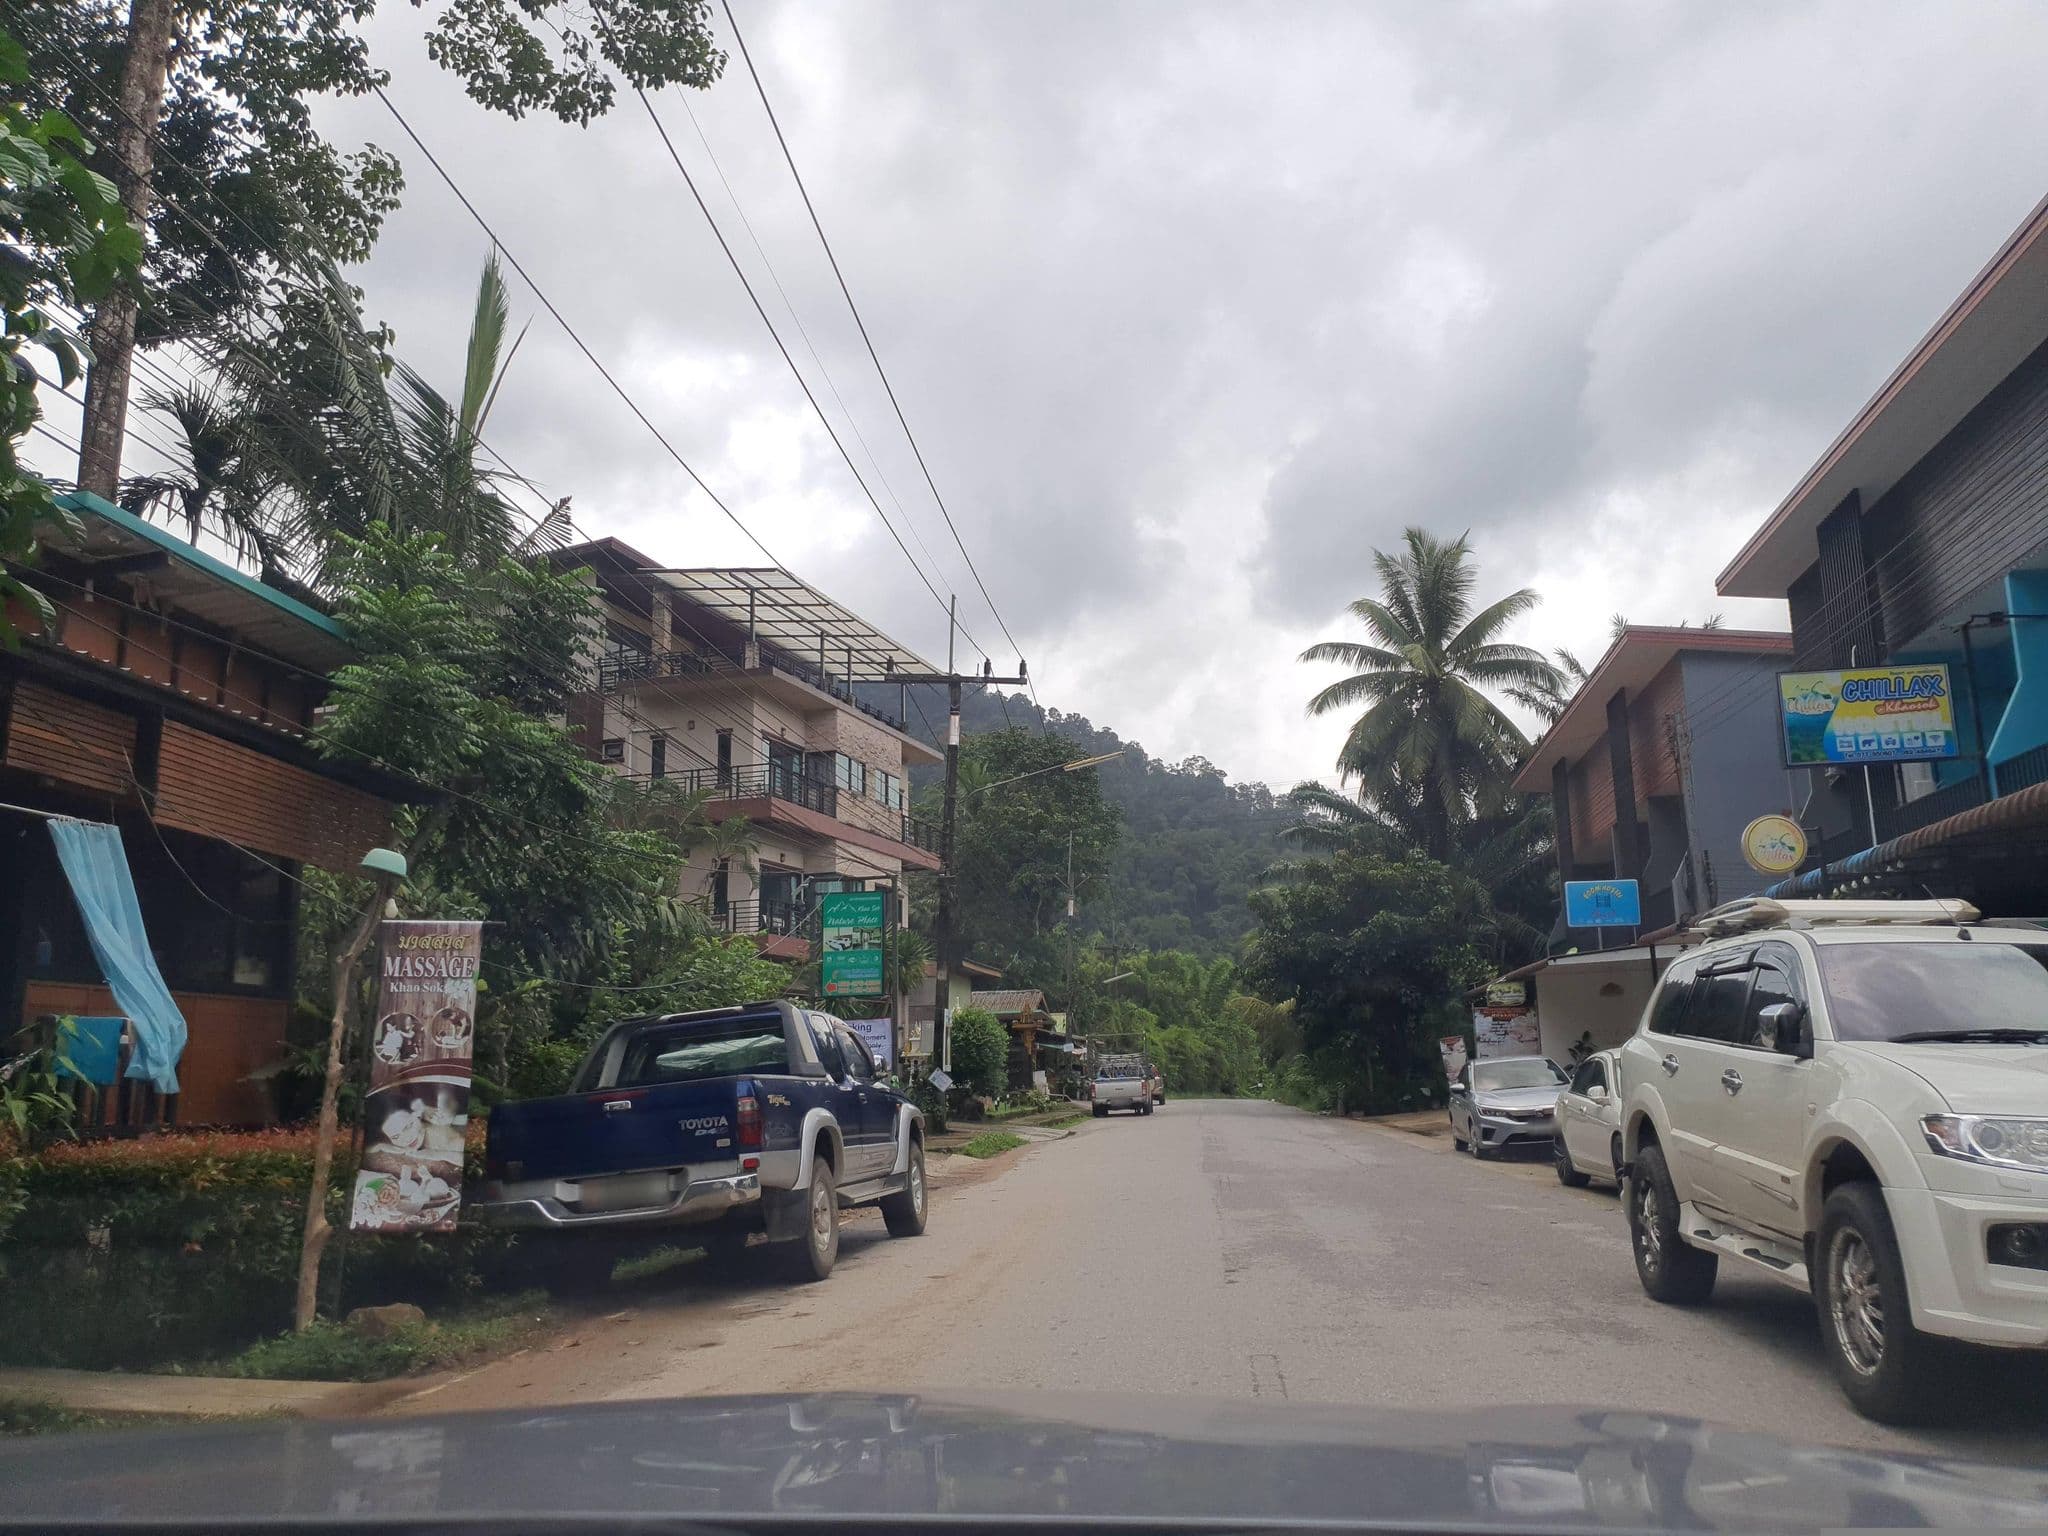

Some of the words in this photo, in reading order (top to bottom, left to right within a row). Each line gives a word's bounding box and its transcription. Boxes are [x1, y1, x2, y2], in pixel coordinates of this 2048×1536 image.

[1842, 675, 1945, 702] CHILLAX
[384, 956, 474, 978] MASSAGE
[389, 982, 420, 993] Khao
[678, 1115, 729, 1130] TOYOTA
